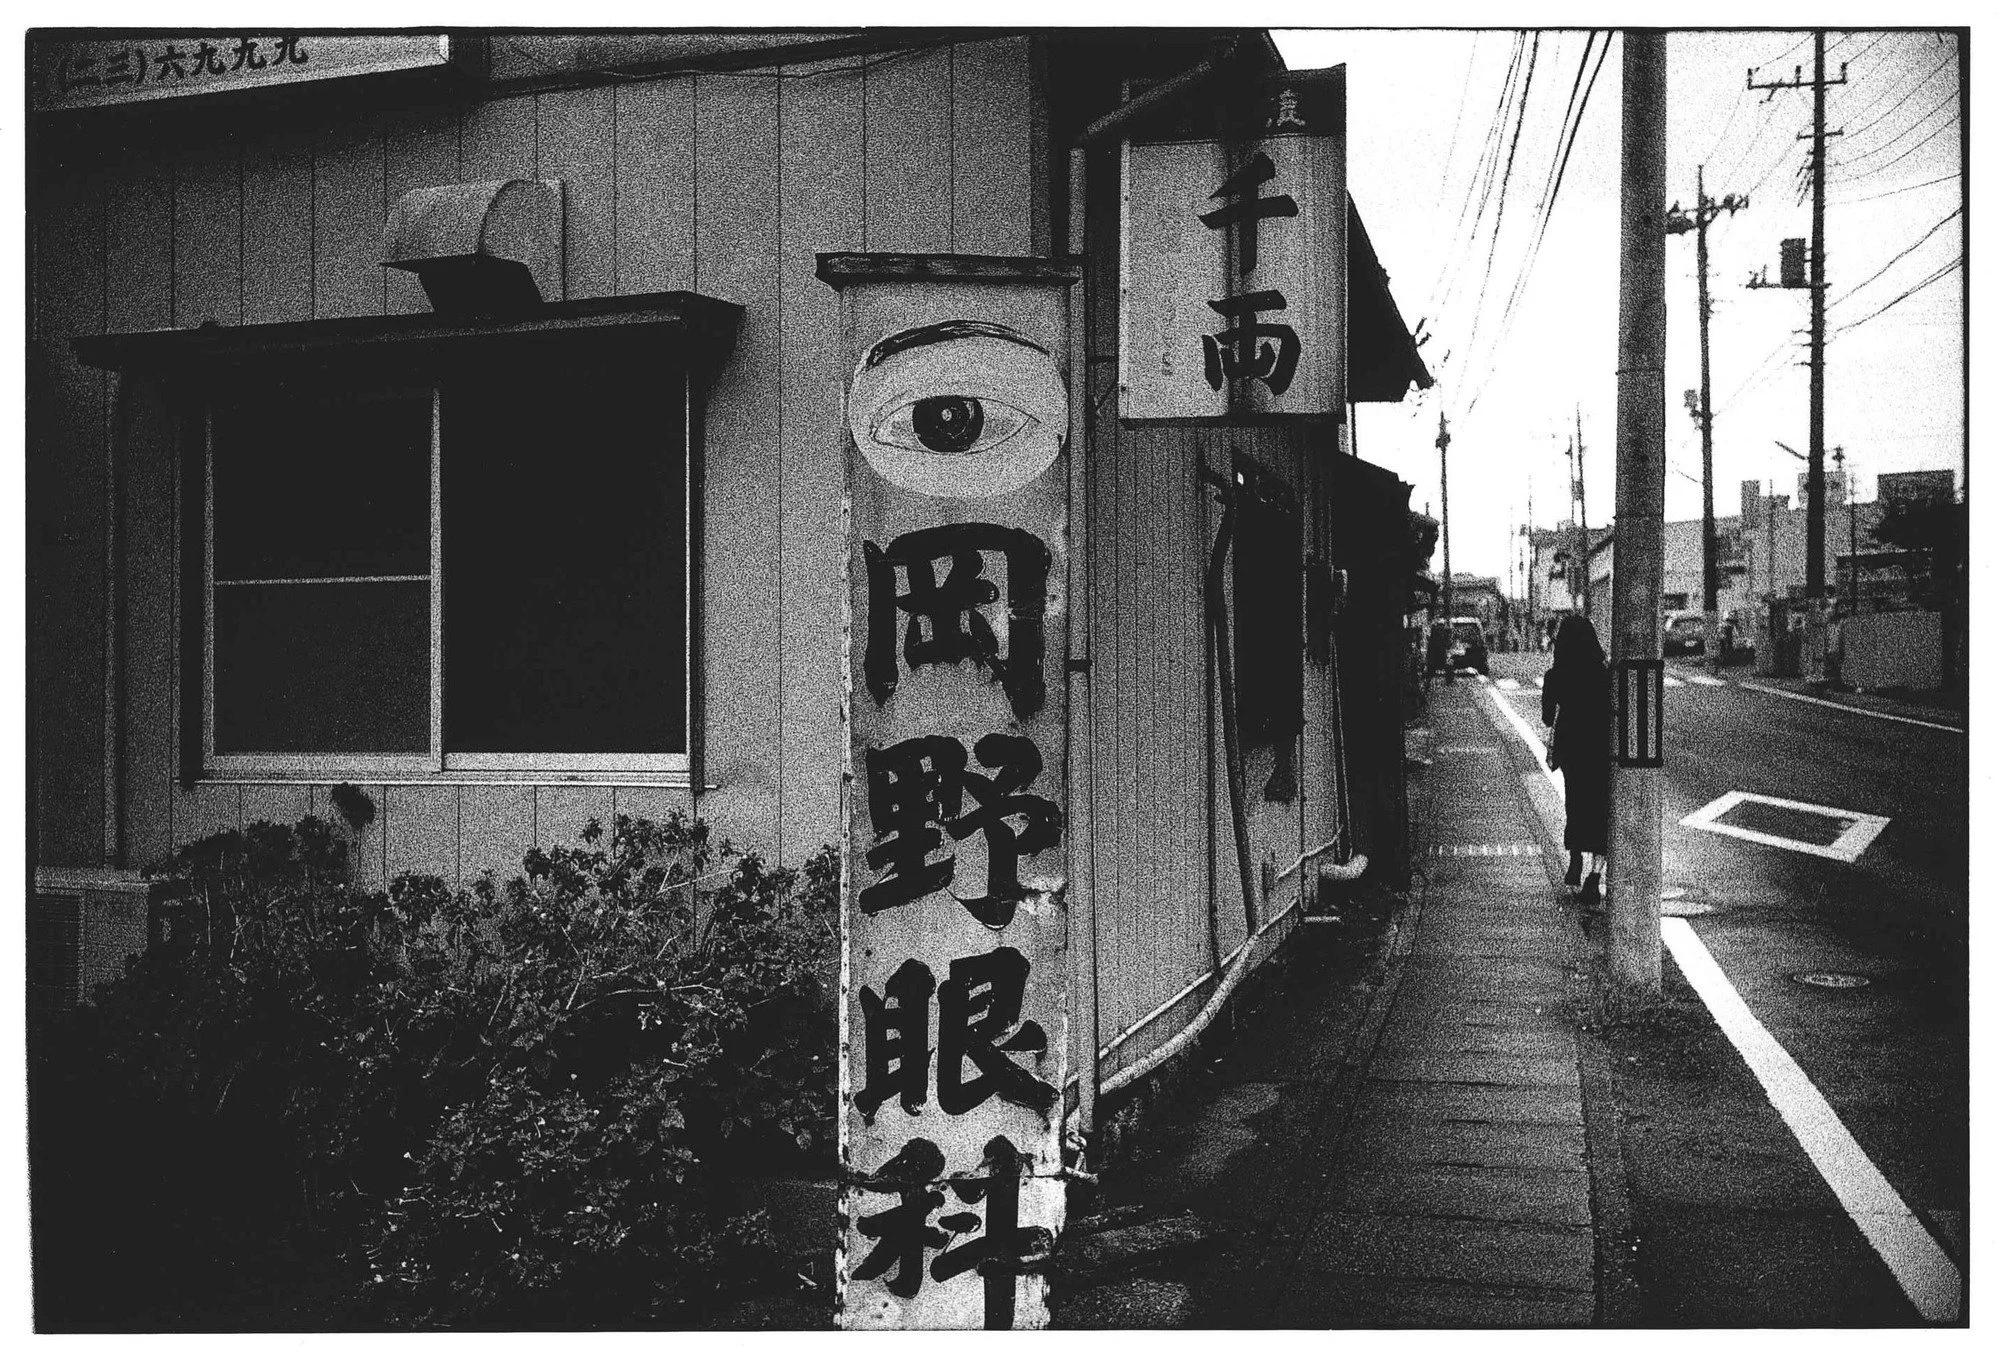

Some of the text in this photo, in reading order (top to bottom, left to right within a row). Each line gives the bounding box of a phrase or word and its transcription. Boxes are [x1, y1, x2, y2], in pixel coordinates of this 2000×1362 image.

[59, 38, 308, 90] (二三)六九九九
[1200, 153, 1301, 397] 千両
[856, 522, 1063, 1330] 岡野眼科
